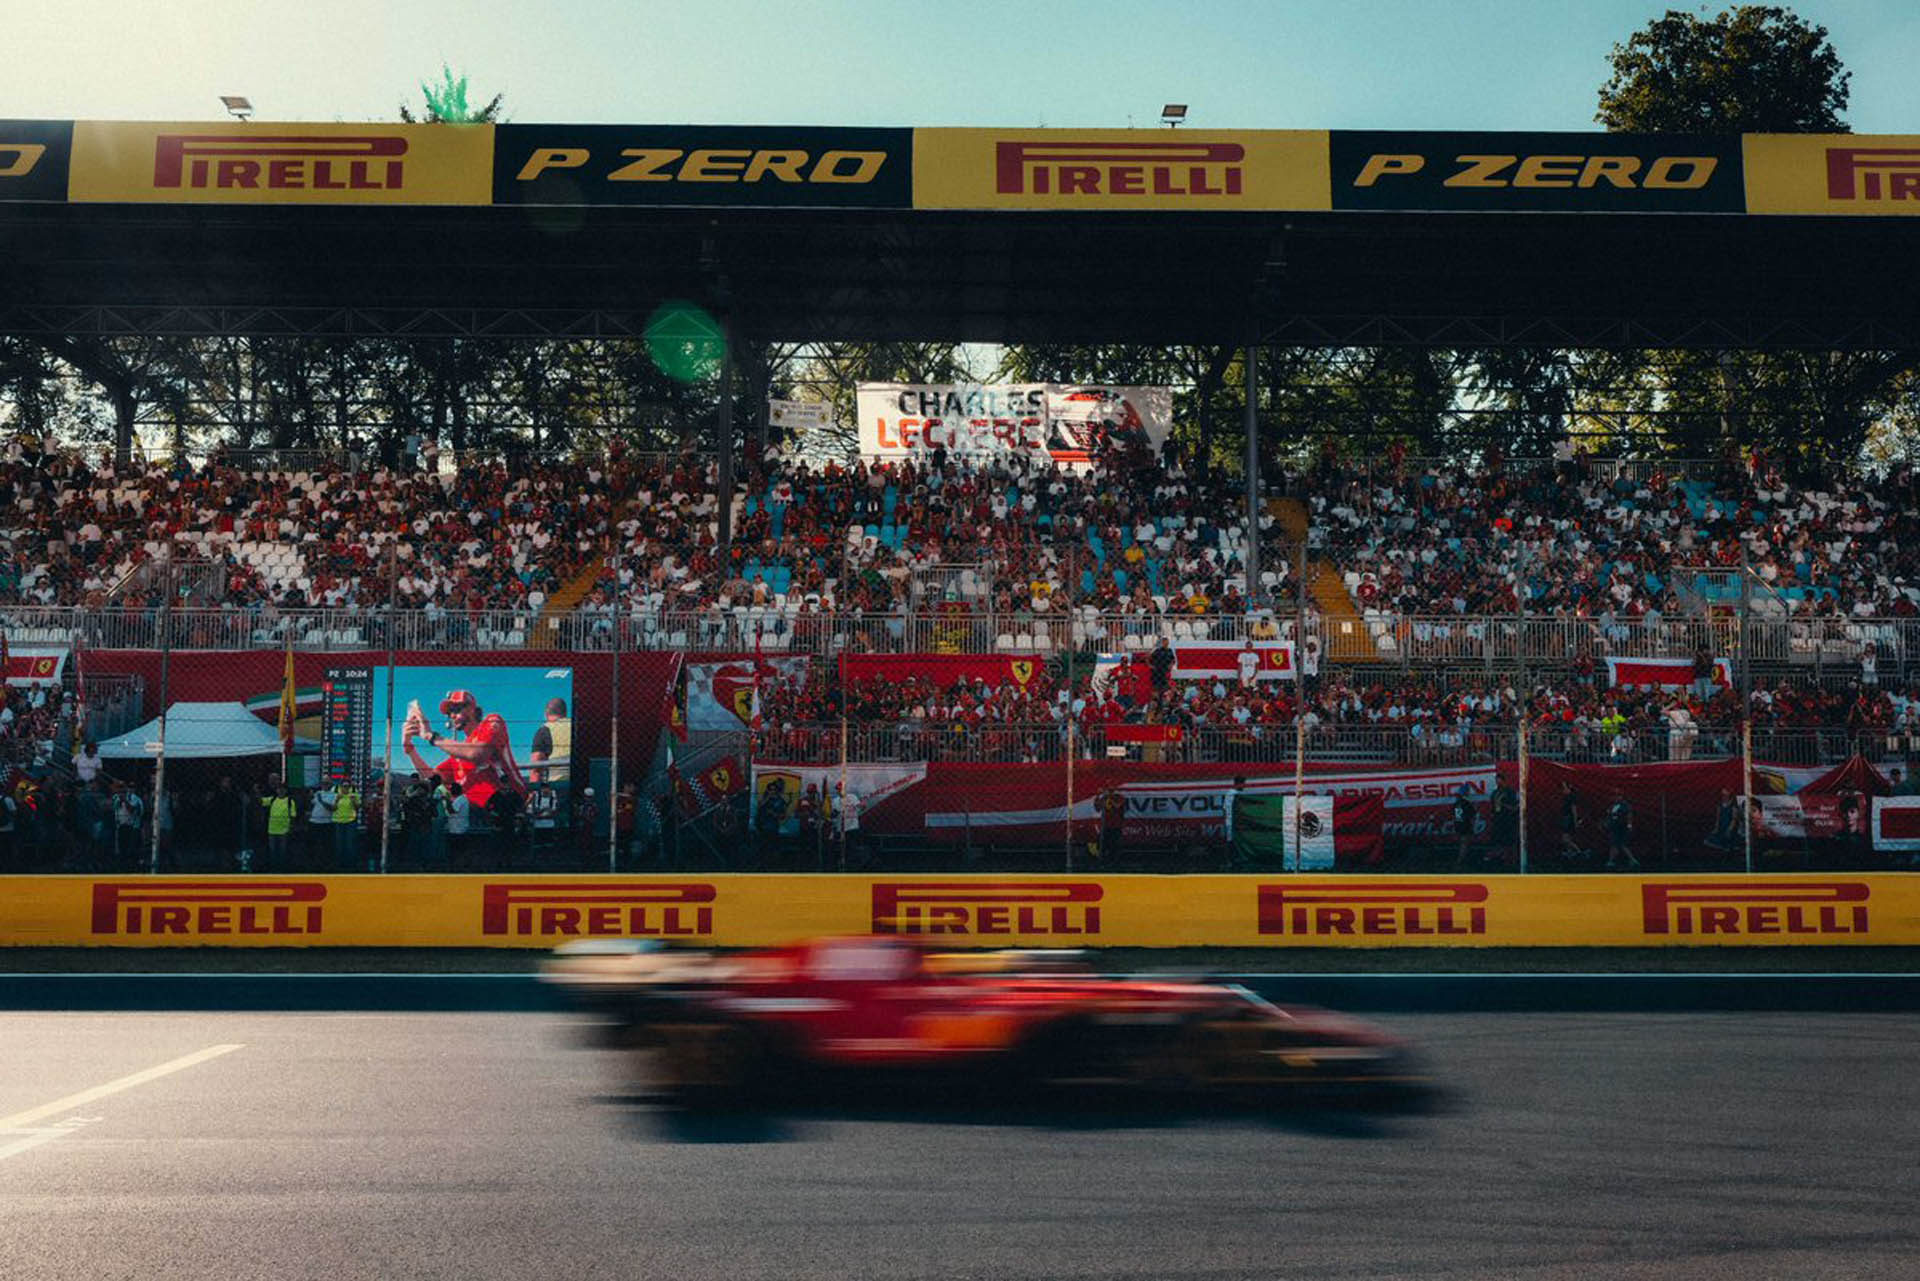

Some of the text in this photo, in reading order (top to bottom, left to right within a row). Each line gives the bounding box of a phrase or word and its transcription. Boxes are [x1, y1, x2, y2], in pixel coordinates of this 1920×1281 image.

[153, 135, 409, 190] PIRELLI
[516, 148, 887, 183] P ZERO
[996, 141, 1245, 195] PIRELLI
[1353, 154, 1718, 189] P ZERO
[92, 882, 328, 935] PIRELLI
[482, 883, 717, 936] PIRELLI
[871, 882, 1104, 935] PIRELLI
[1257, 882, 1489, 934] PIRELLI
[1641, 882, 1871, 934] PIRELLI
